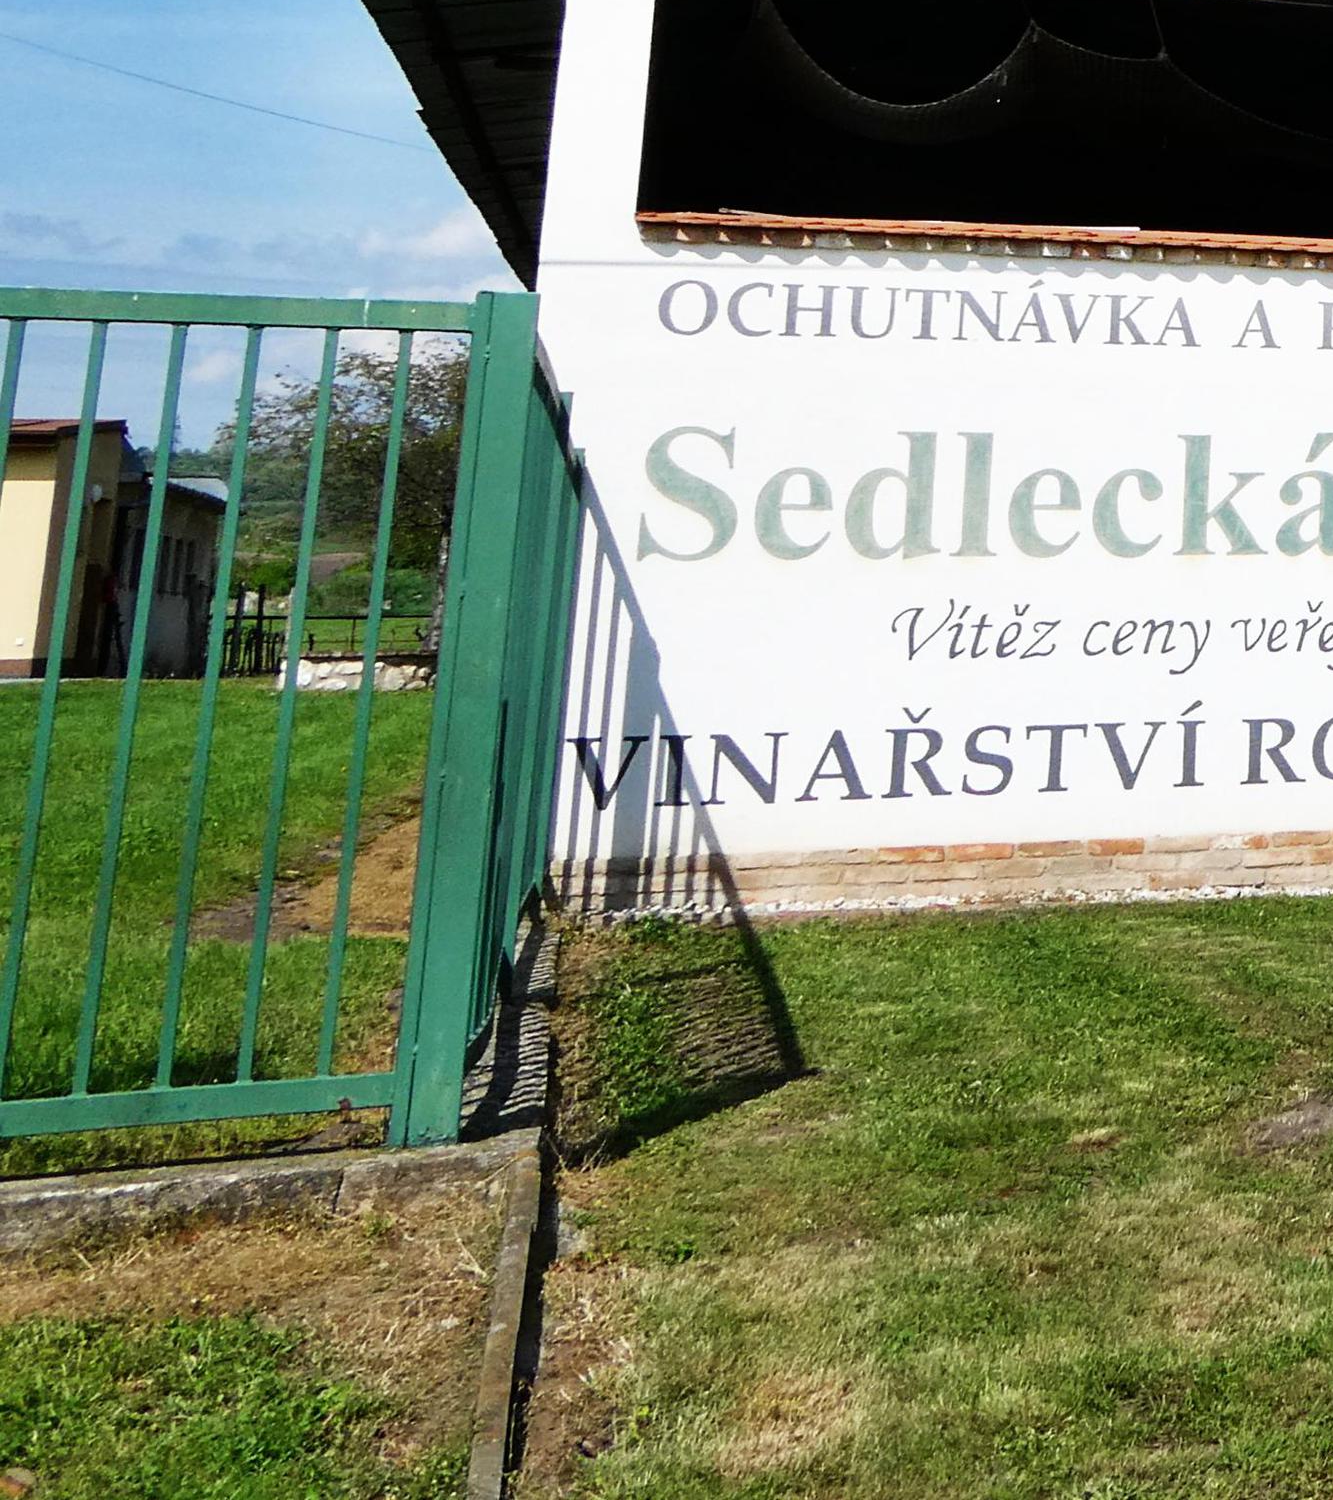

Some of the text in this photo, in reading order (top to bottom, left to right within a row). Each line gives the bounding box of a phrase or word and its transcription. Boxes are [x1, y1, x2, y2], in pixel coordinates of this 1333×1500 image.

[658, 279, 1202, 348] OCHUTNÁVKA
[1230, 299, 1282, 349] A
[890, 598, 1062, 661] Vítěz
[1082, 618, 1212, 675] ceny
[566, 699, 1207, 811] VINAŘSTVÍ
